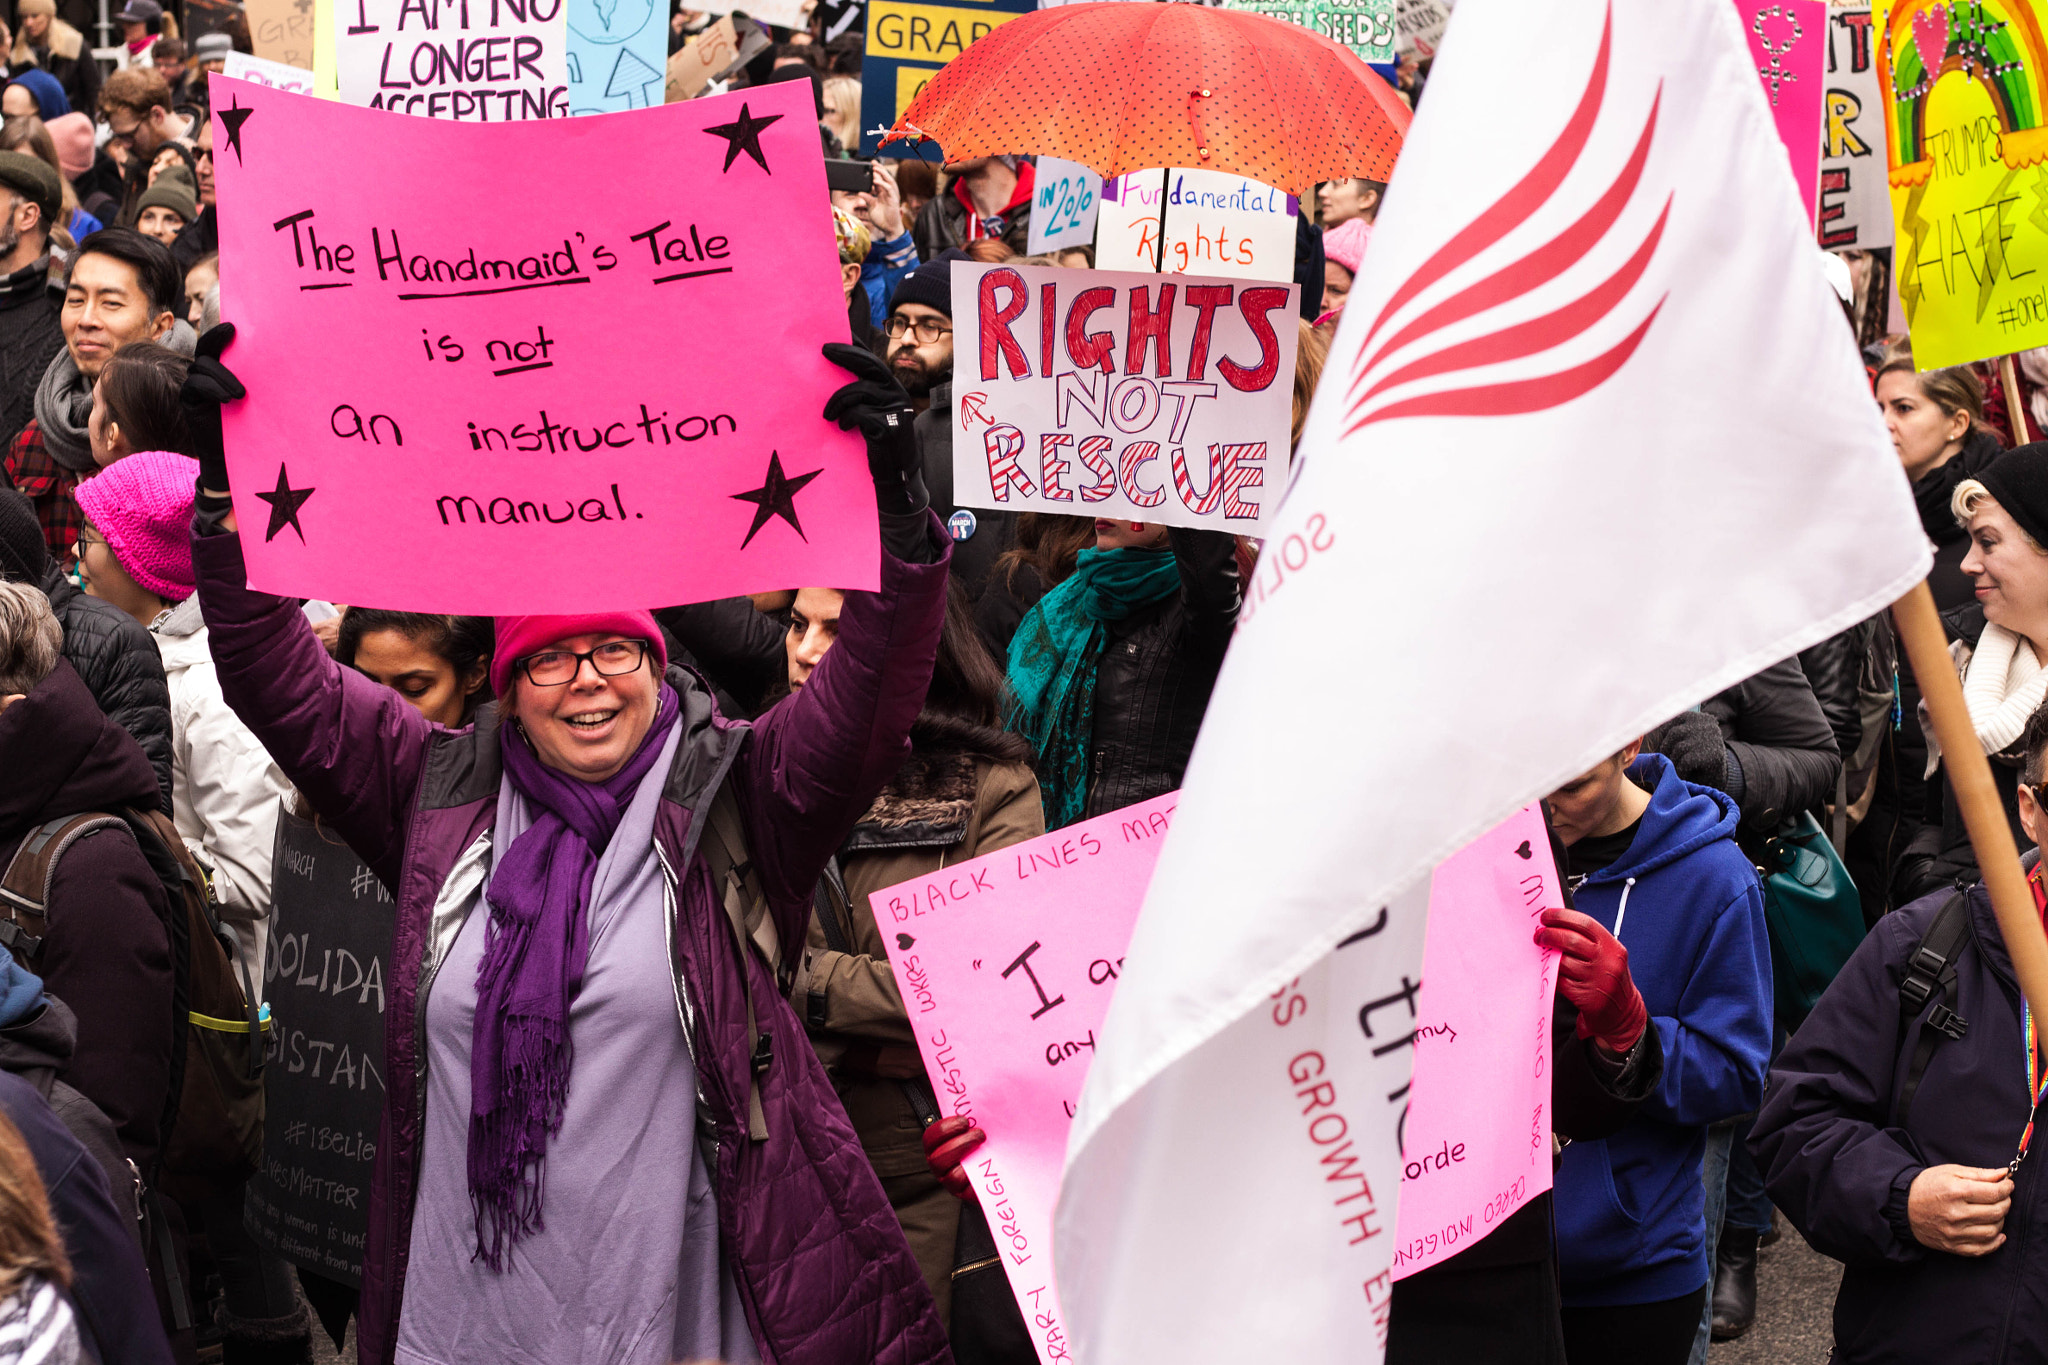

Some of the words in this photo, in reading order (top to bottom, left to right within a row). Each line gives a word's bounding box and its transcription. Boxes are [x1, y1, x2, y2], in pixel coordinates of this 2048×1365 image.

[1316, 12, 1393, 47] SEEDS
[380, 35, 545, 89] LONGER
[1922, 115, 2003, 181] TRUMPS
[1039, 182, 1056, 209] IN
[1044, 176, 1092, 237] 2020
[273, 210, 355, 273] The
[371, 227, 617, 282] Handmaid's
[631, 221, 732, 265] Tale
[1128, 217, 1254, 272] Rights
[1914, 196, 2037, 302] HATE
[422, 330, 464, 362] is
[486, 326, 553, 364] not
[978, 267, 1290, 393] RIGHTS
[331, 404, 403, 446] an
[469, 404, 737, 454] instruction
[1056, 370, 1217, 444] NOT
[983, 423, 1267, 520] RESCUE
[436, 484, 643, 526] manual.
[889, 867, 995, 923] BLACK
[1017, 832, 1101, 880] LIVES
[266, 903, 386, 1014] SOLIDA
[1520, 874, 1553, 1000] MIING
[1089, 957, 1126, 985] a
[931, 1029, 977, 1128] OMESTIC
[1046, 1030, 1096, 1066] any
[1289, 1050, 1382, 1246] GROWTH
[1401, 1141, 1465, 1182] orde
[284, 1212, 318, 1235] woman
[328, 1222, 338, 1240] is
[978, 1158, 1032, 1266] FOREIGN
[325, 1250, 347, 1270] from
